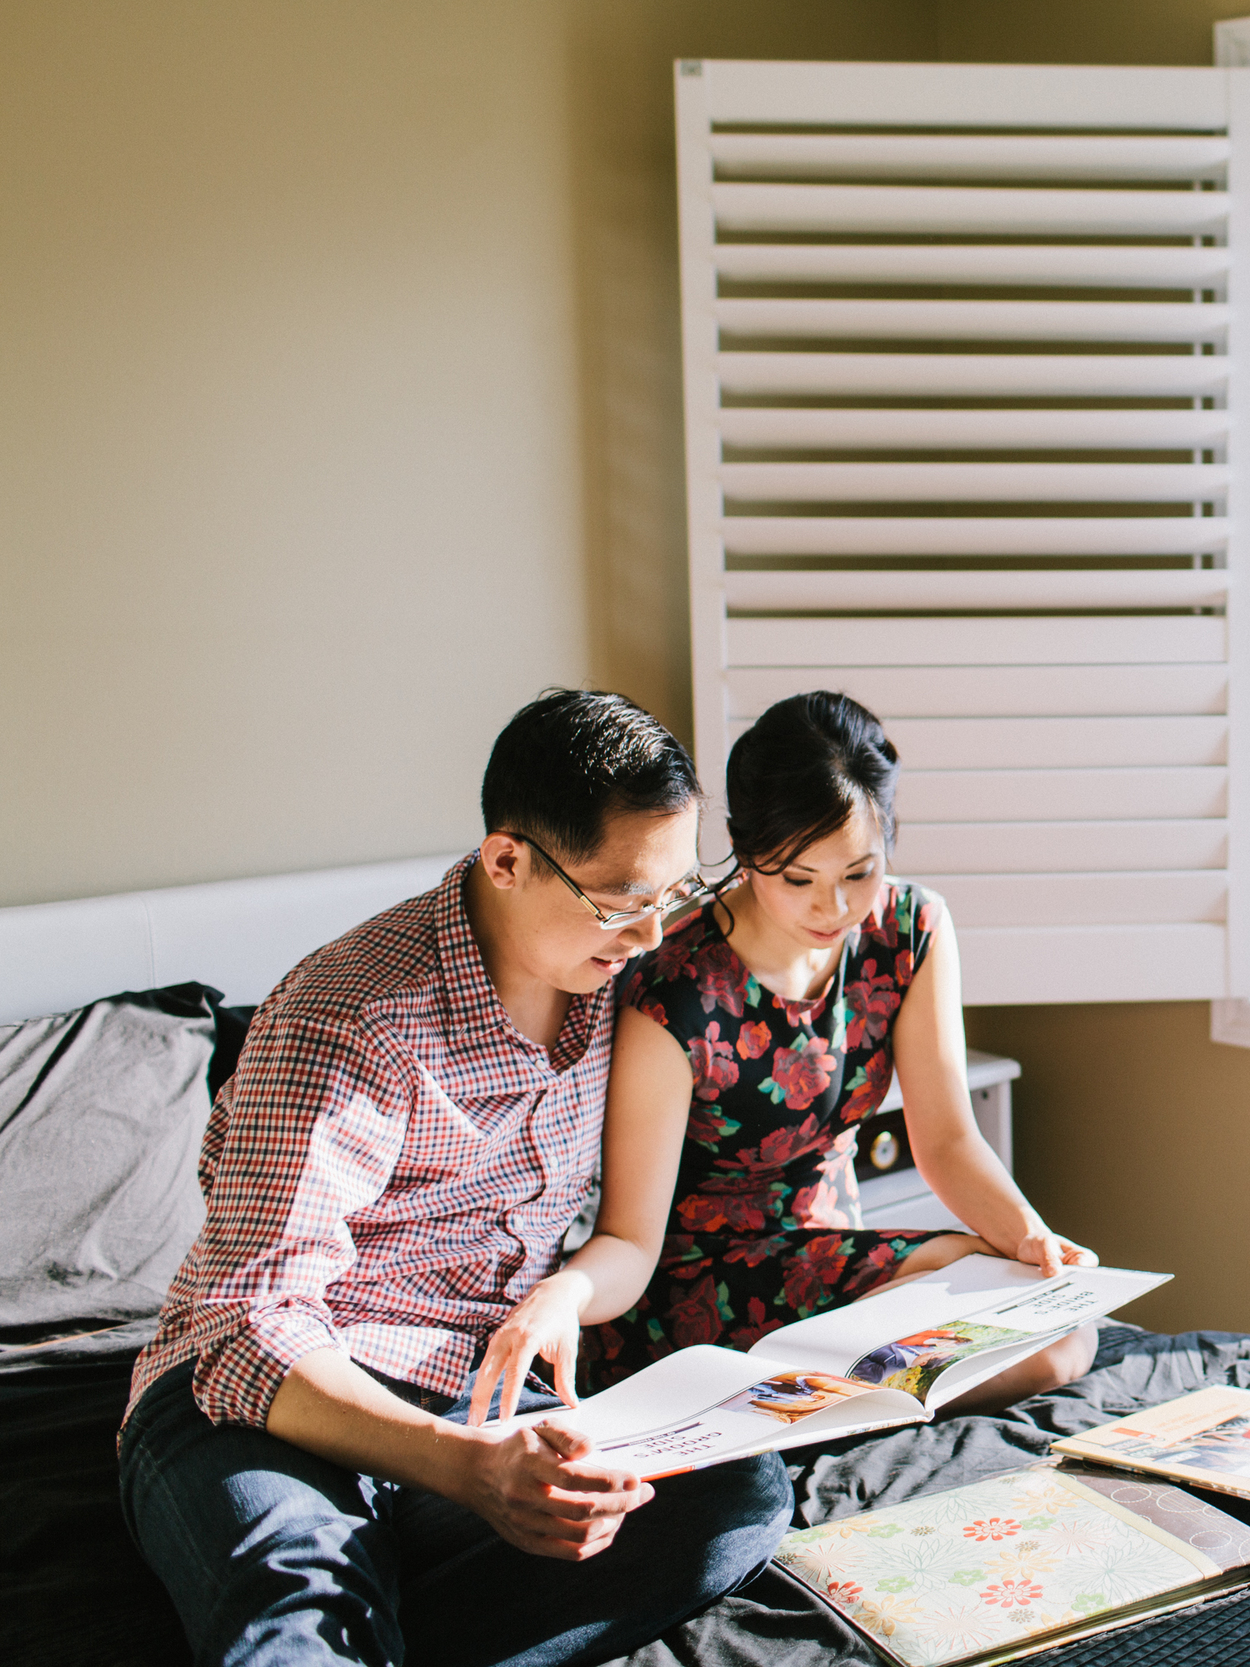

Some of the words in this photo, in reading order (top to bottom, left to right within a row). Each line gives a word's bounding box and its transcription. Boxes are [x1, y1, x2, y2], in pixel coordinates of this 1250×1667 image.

[1029, 1294, 1066, 1308] SIDE
[1034, 1291, 1094, 1315] BRIDE'S
[1064, 1300, 1098, 1312] THE
[633, 1431, 722, 1458] GROOM'S
[639, 1435, 686, 1449] SIDE
[673, 1444, 716, 1457] THE
